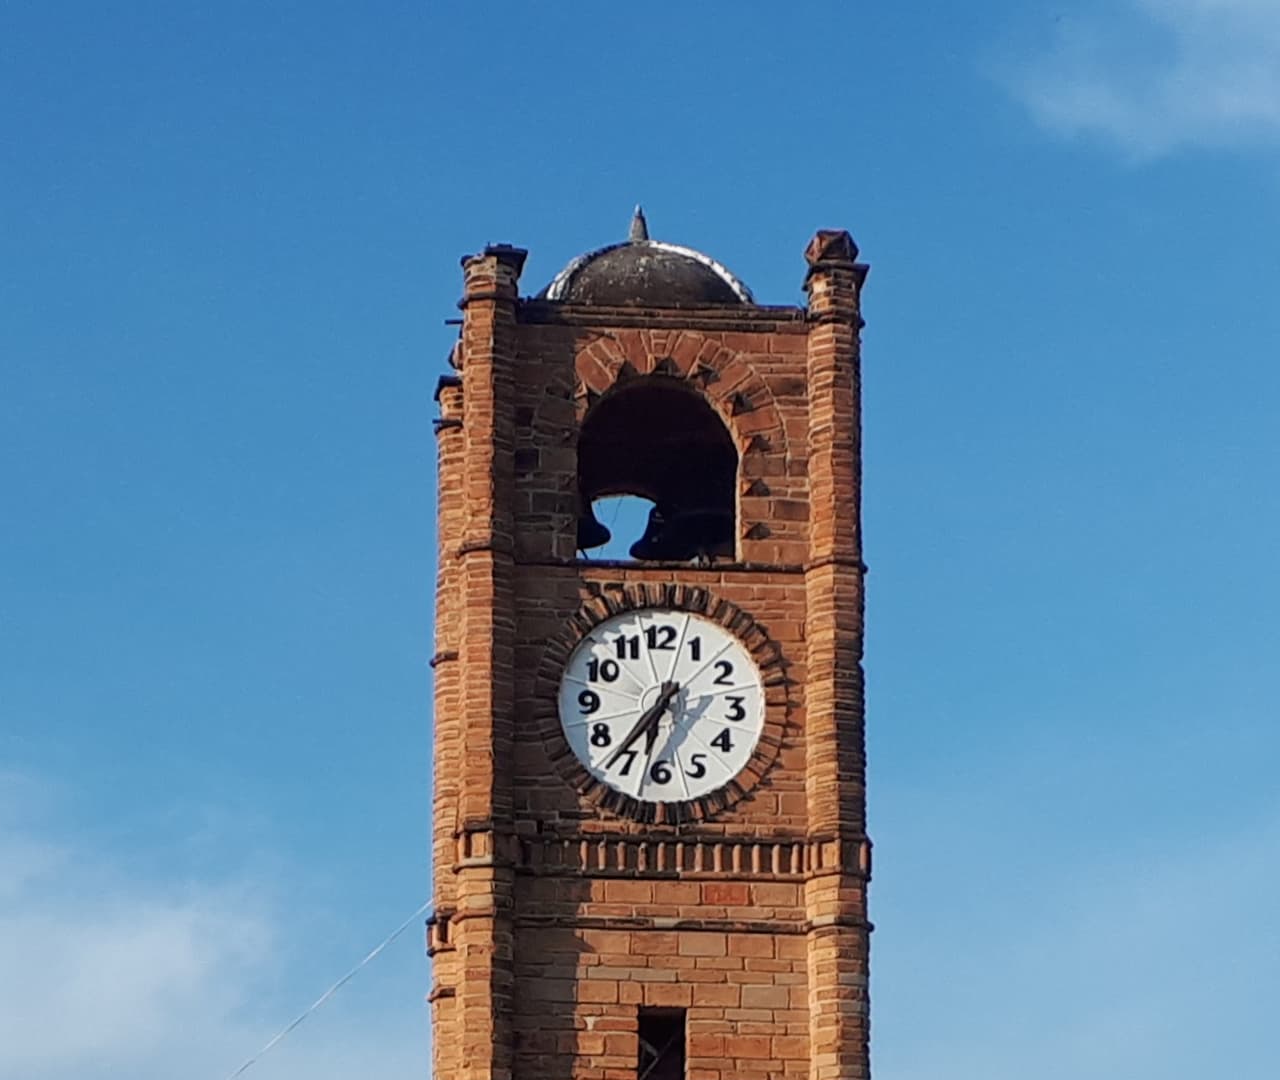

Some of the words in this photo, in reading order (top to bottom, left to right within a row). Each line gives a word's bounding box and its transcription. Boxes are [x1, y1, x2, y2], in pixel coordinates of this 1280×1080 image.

[613, 635, 640, 660] 11
[644, 625, 677, 650] 12
[688, 637, 701, 661] 1
[586, 658, 620, 683] 10
[713, 660, 734, 685] 2
[578, 690, 601, 714] 9
[724, 696, 746, 722] 3
[590, 723, 611, 747] 8
[710, 728, 735, 752] 4
[618, 751, 638, 776] 7
[650, 760, 672, 784] 6
[685, 754, 707, 779] 5
